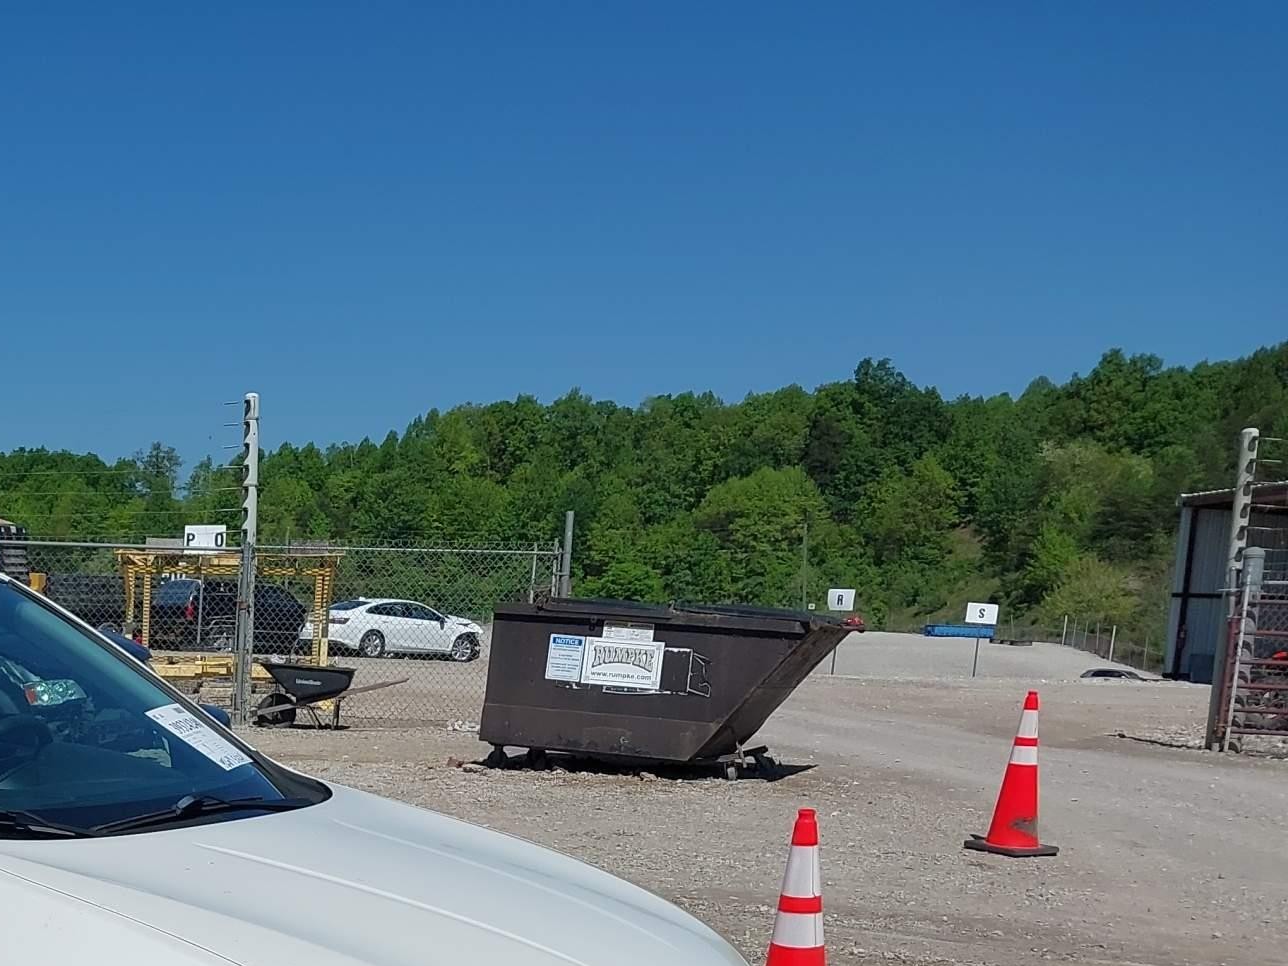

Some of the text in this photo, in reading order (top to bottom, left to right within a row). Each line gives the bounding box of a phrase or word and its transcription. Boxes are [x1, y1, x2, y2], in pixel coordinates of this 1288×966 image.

[186, 533, 195, 546] P
[837, 595, 844, 605] R
[979, 608, 986, 618] S
[555, 637, 580, 646] NOTICE
[592, 645, 654, 672] RUMPKE
[591, 671, 652, 681] www.rumpke.com
